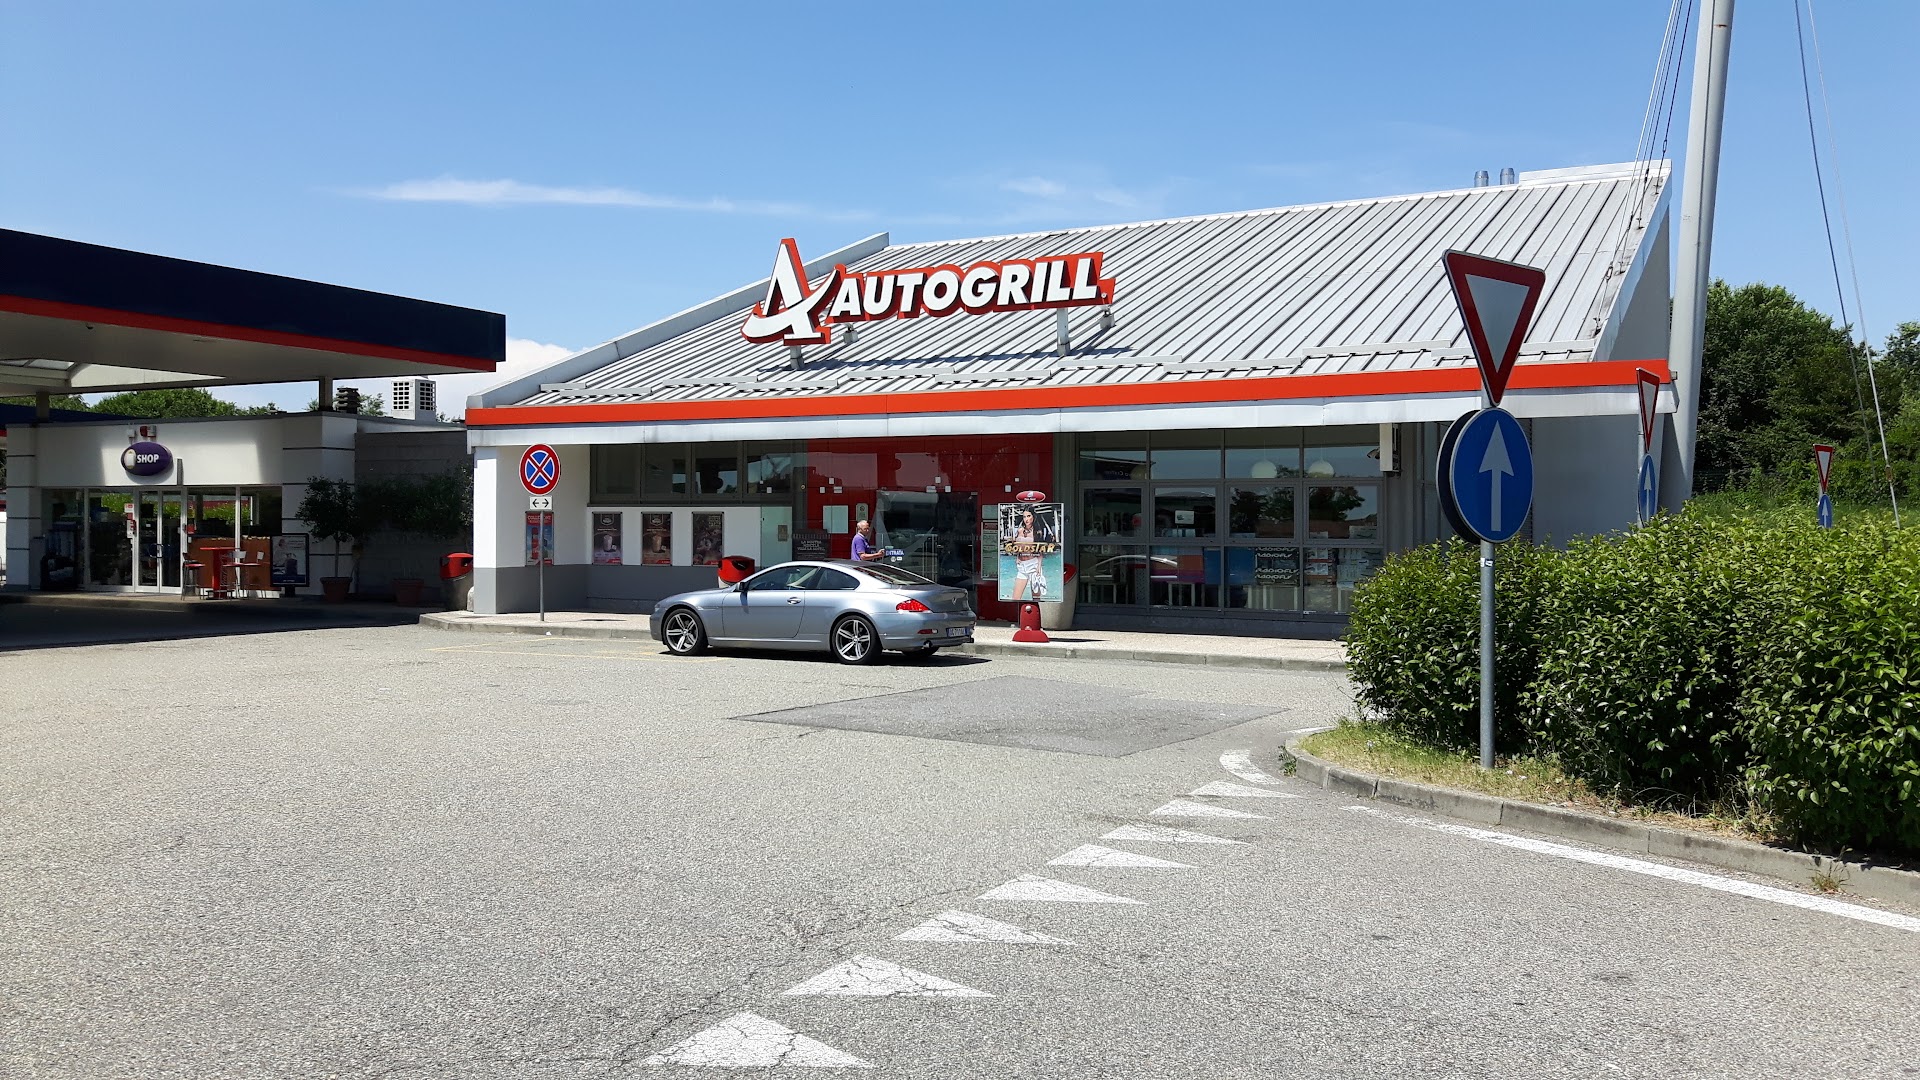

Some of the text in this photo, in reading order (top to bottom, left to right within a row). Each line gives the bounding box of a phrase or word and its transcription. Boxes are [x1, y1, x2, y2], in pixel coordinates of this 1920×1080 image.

[829, 257, 1100, 318] AUTOGRILL
[136, 453, 160, 464] SHOP
[1004, 541, 1056, 553] GOLDSTAR
